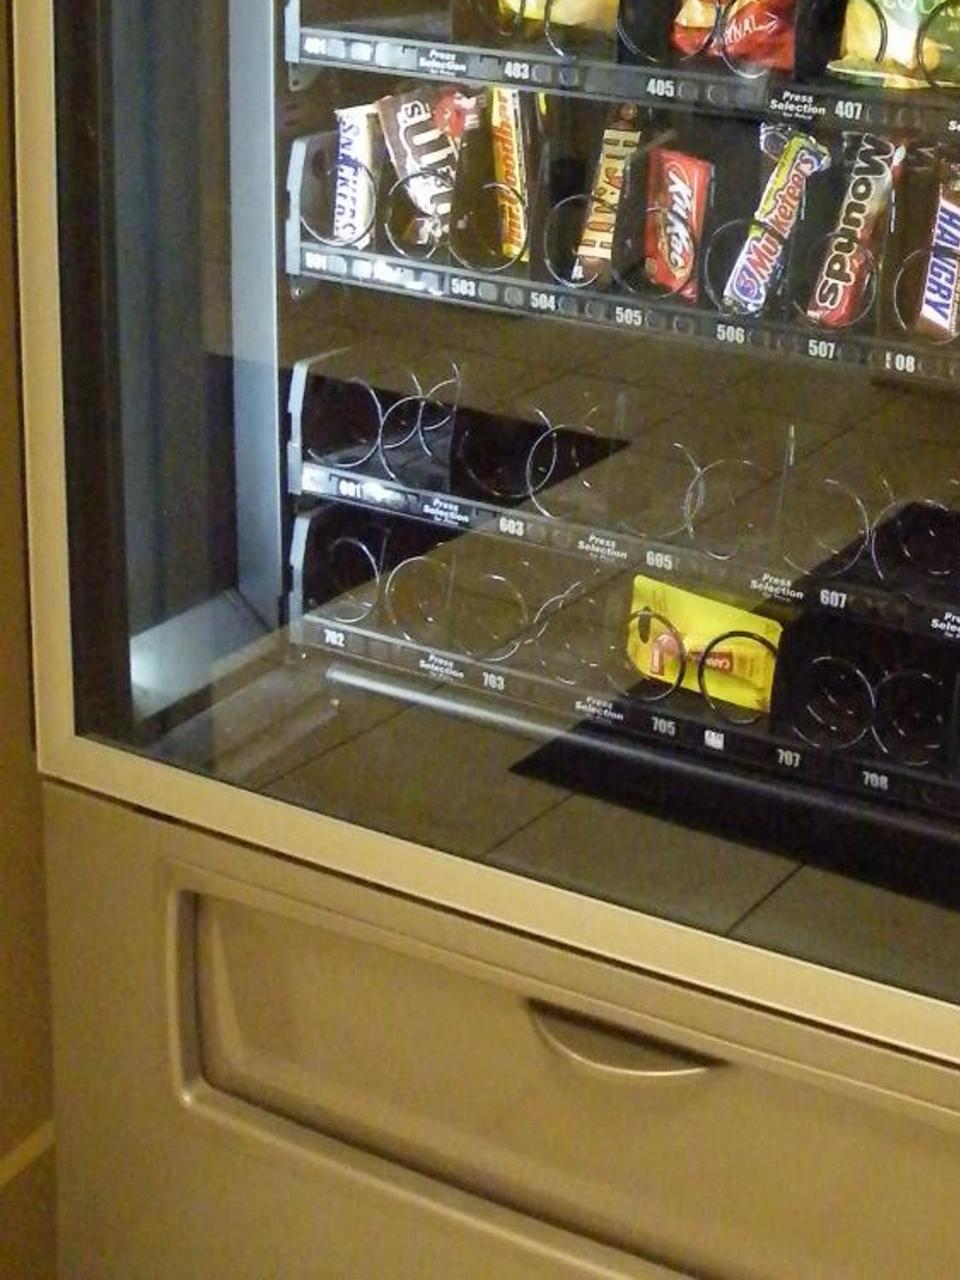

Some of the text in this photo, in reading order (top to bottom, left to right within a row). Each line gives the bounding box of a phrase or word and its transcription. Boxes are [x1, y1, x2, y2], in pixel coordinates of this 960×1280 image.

[503, 61, 530, 80] 403
[646, 78, 675, 98] 405
[782, 90, 814, 104] Press
[769, 99, 827, 116] Selection
[834, 100, 863, 120] 407
[746, 150, 820, 286] Muketeers
[451, 277, 476, 297] 503
[530, 295, 556, 312] 504
[614, 306, 642, 326] 505
[716, 324, 745, 344] 506
[807, 338, 836, 359] 507
[499, 517, 525, 537] 603
[577, 541, 628, 561] Selection
[587, 535, 617, 548] Press
[646, 550, 673, 570] 605
[749, 579, 804, 601] Selection
[761, 572, 793, 588] Press
[819, 589, 848, 609] 607
[574, 701, 625, 722] Selection
[585, 695, 615, 711] Press
[651, 715, 677, 737] 705
[777, 748, 802, 769] 707
[862, 771, 889, 791] 708
